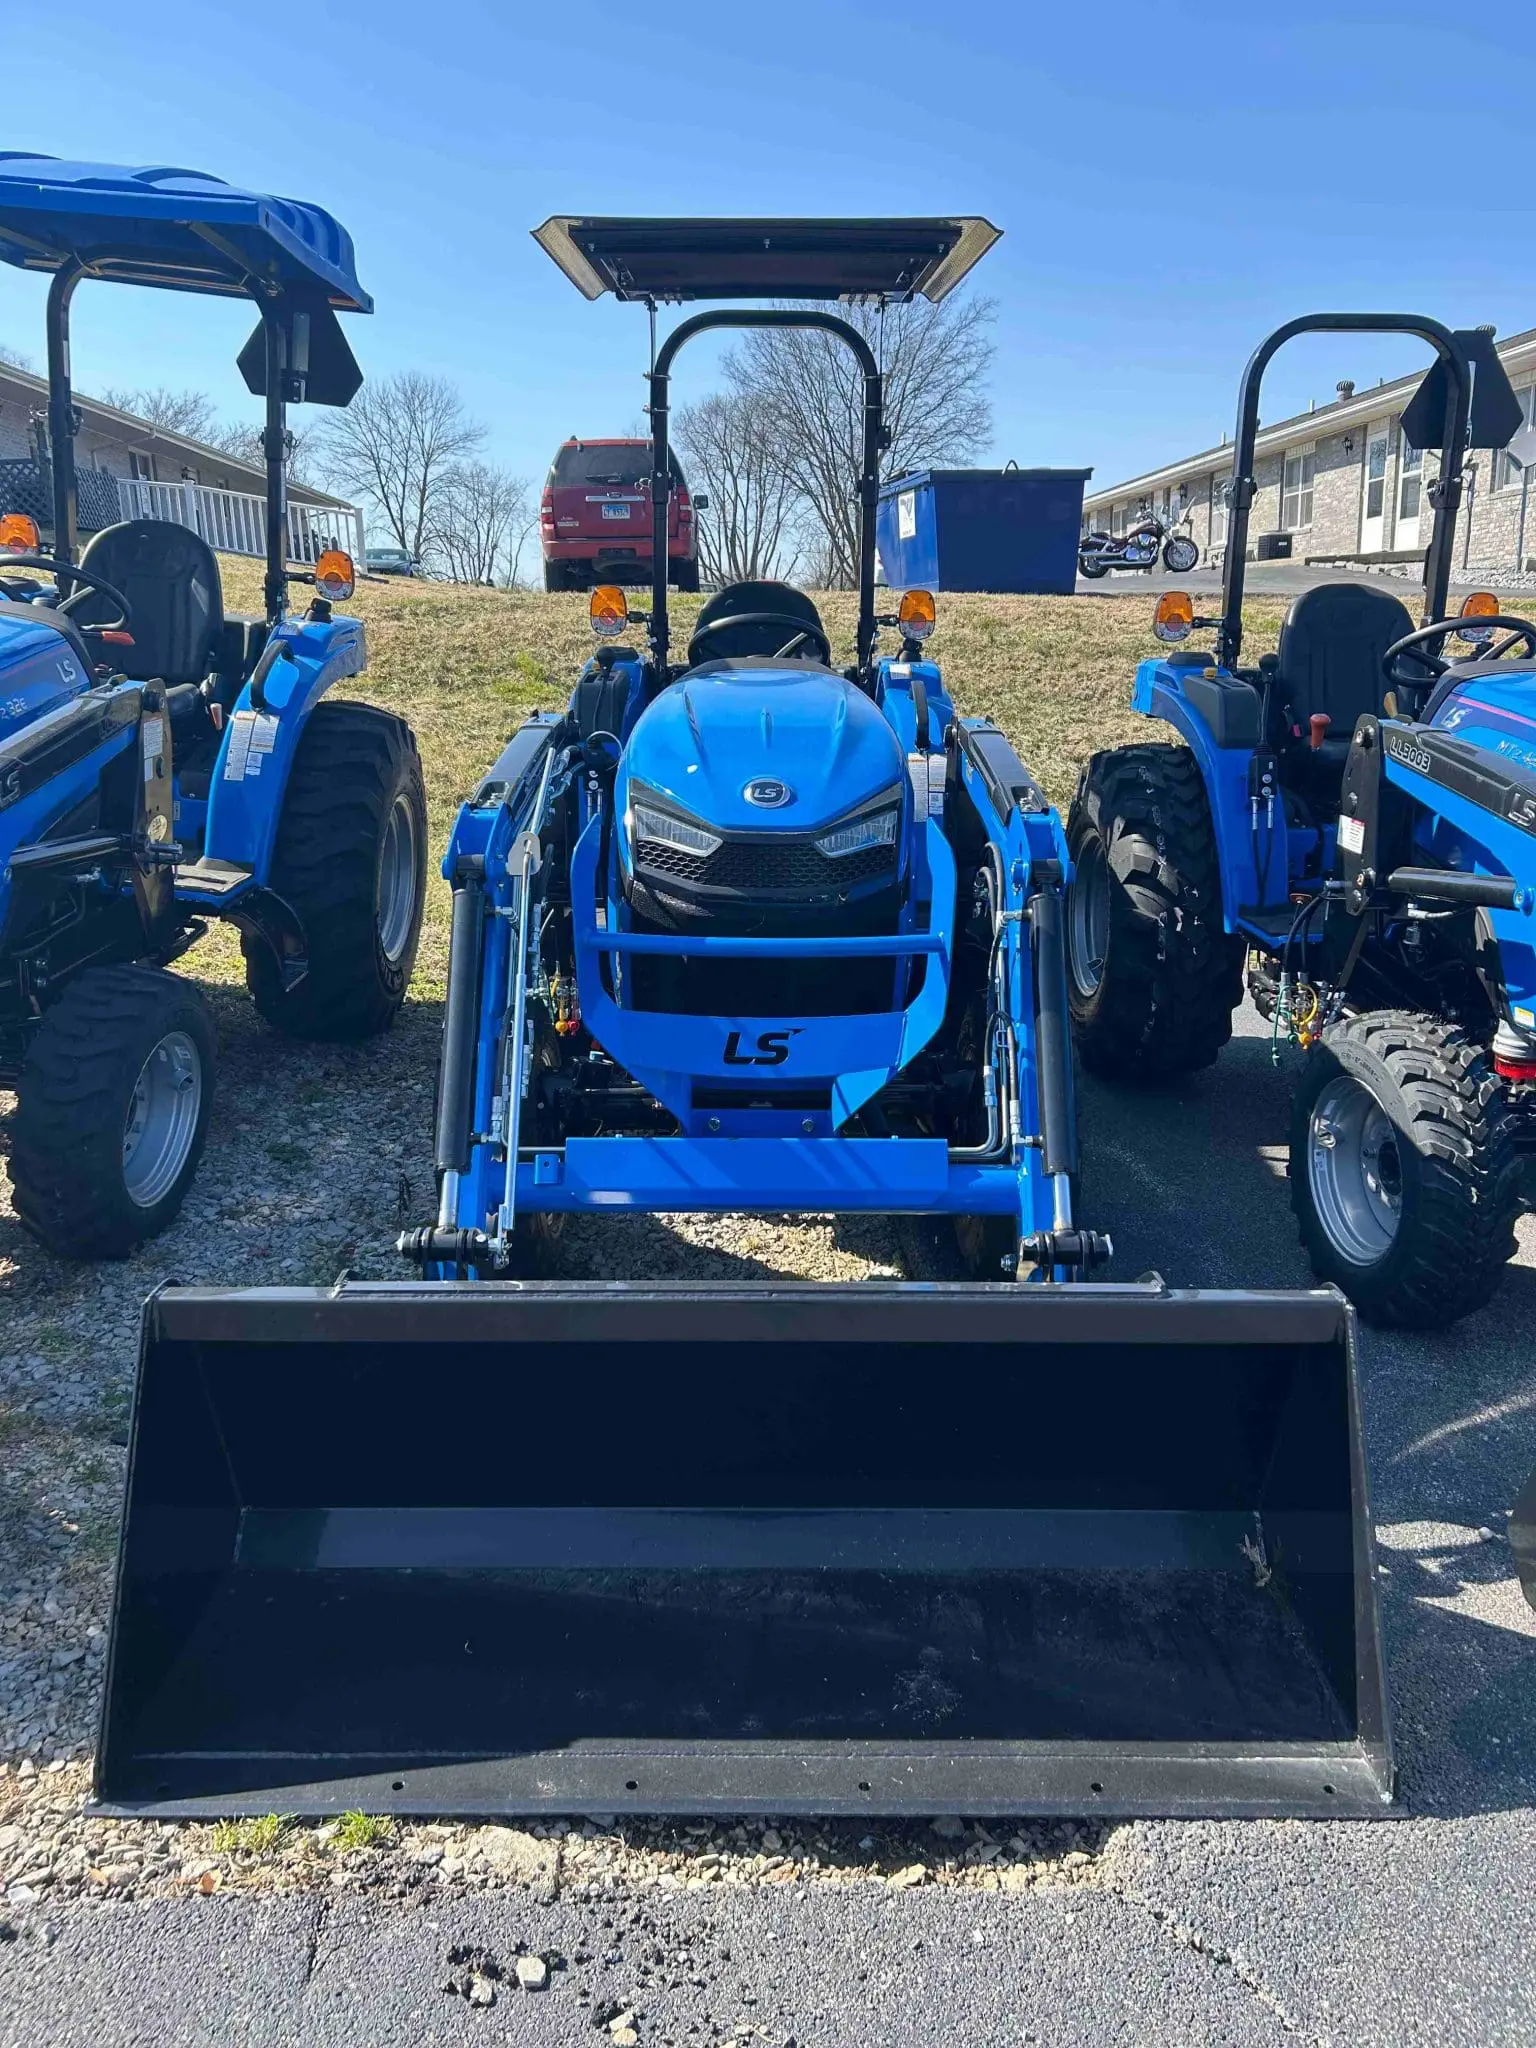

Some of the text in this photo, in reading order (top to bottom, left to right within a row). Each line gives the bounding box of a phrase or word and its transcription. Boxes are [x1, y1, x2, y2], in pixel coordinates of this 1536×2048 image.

[56, 660, 76, 683] LS
[1442, 707, 1468, 728] LS
[1389, 736, 1431, 773] LL3003
[753, 787, 777, 798] LS
[1508, 793, 1536, 827] LS
[723, 1030, 790, 1065] LS
